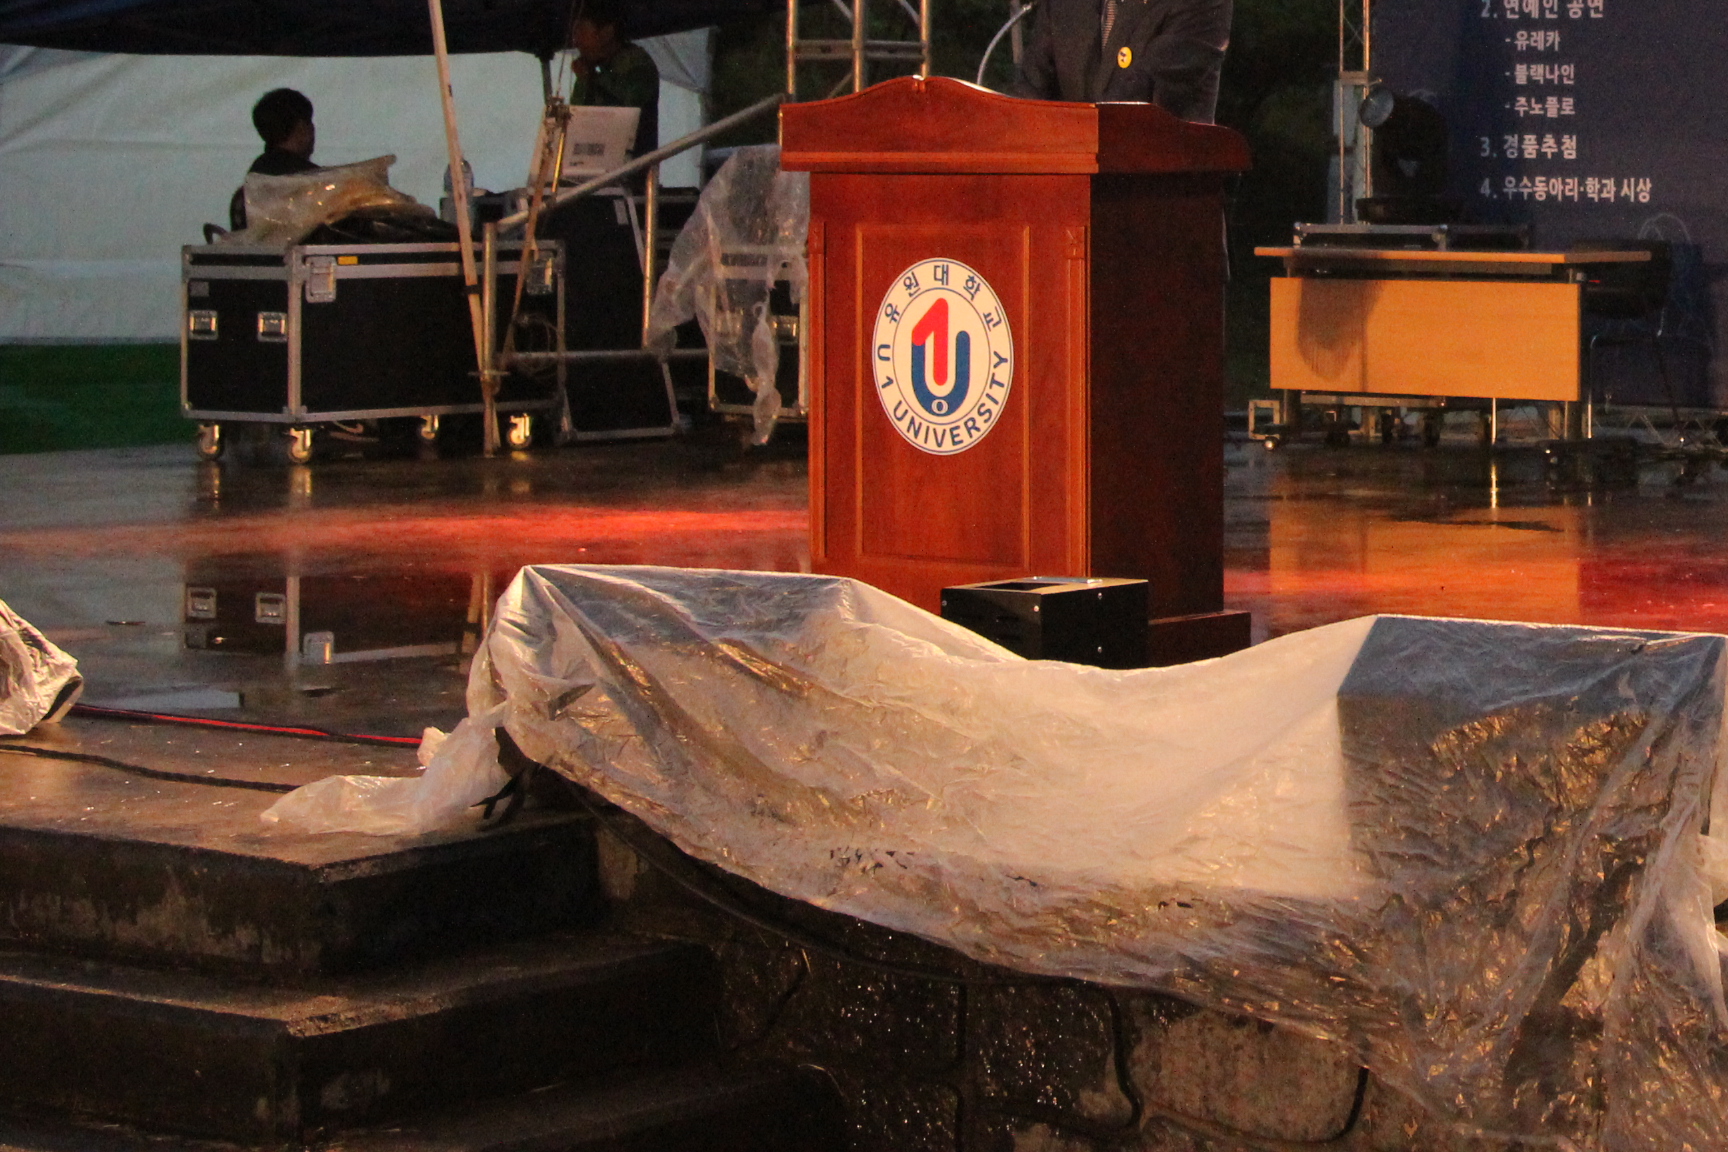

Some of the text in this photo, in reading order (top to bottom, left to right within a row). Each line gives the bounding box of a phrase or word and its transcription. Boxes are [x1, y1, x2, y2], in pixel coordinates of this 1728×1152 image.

[1503, 134, 1577, 159] 경품추첨
[1620, 177, 1652, 202] 시상
[884, 263, 1003, 332] 유원대학교
[893, 350, 1009, 448] UNIVERSITY
